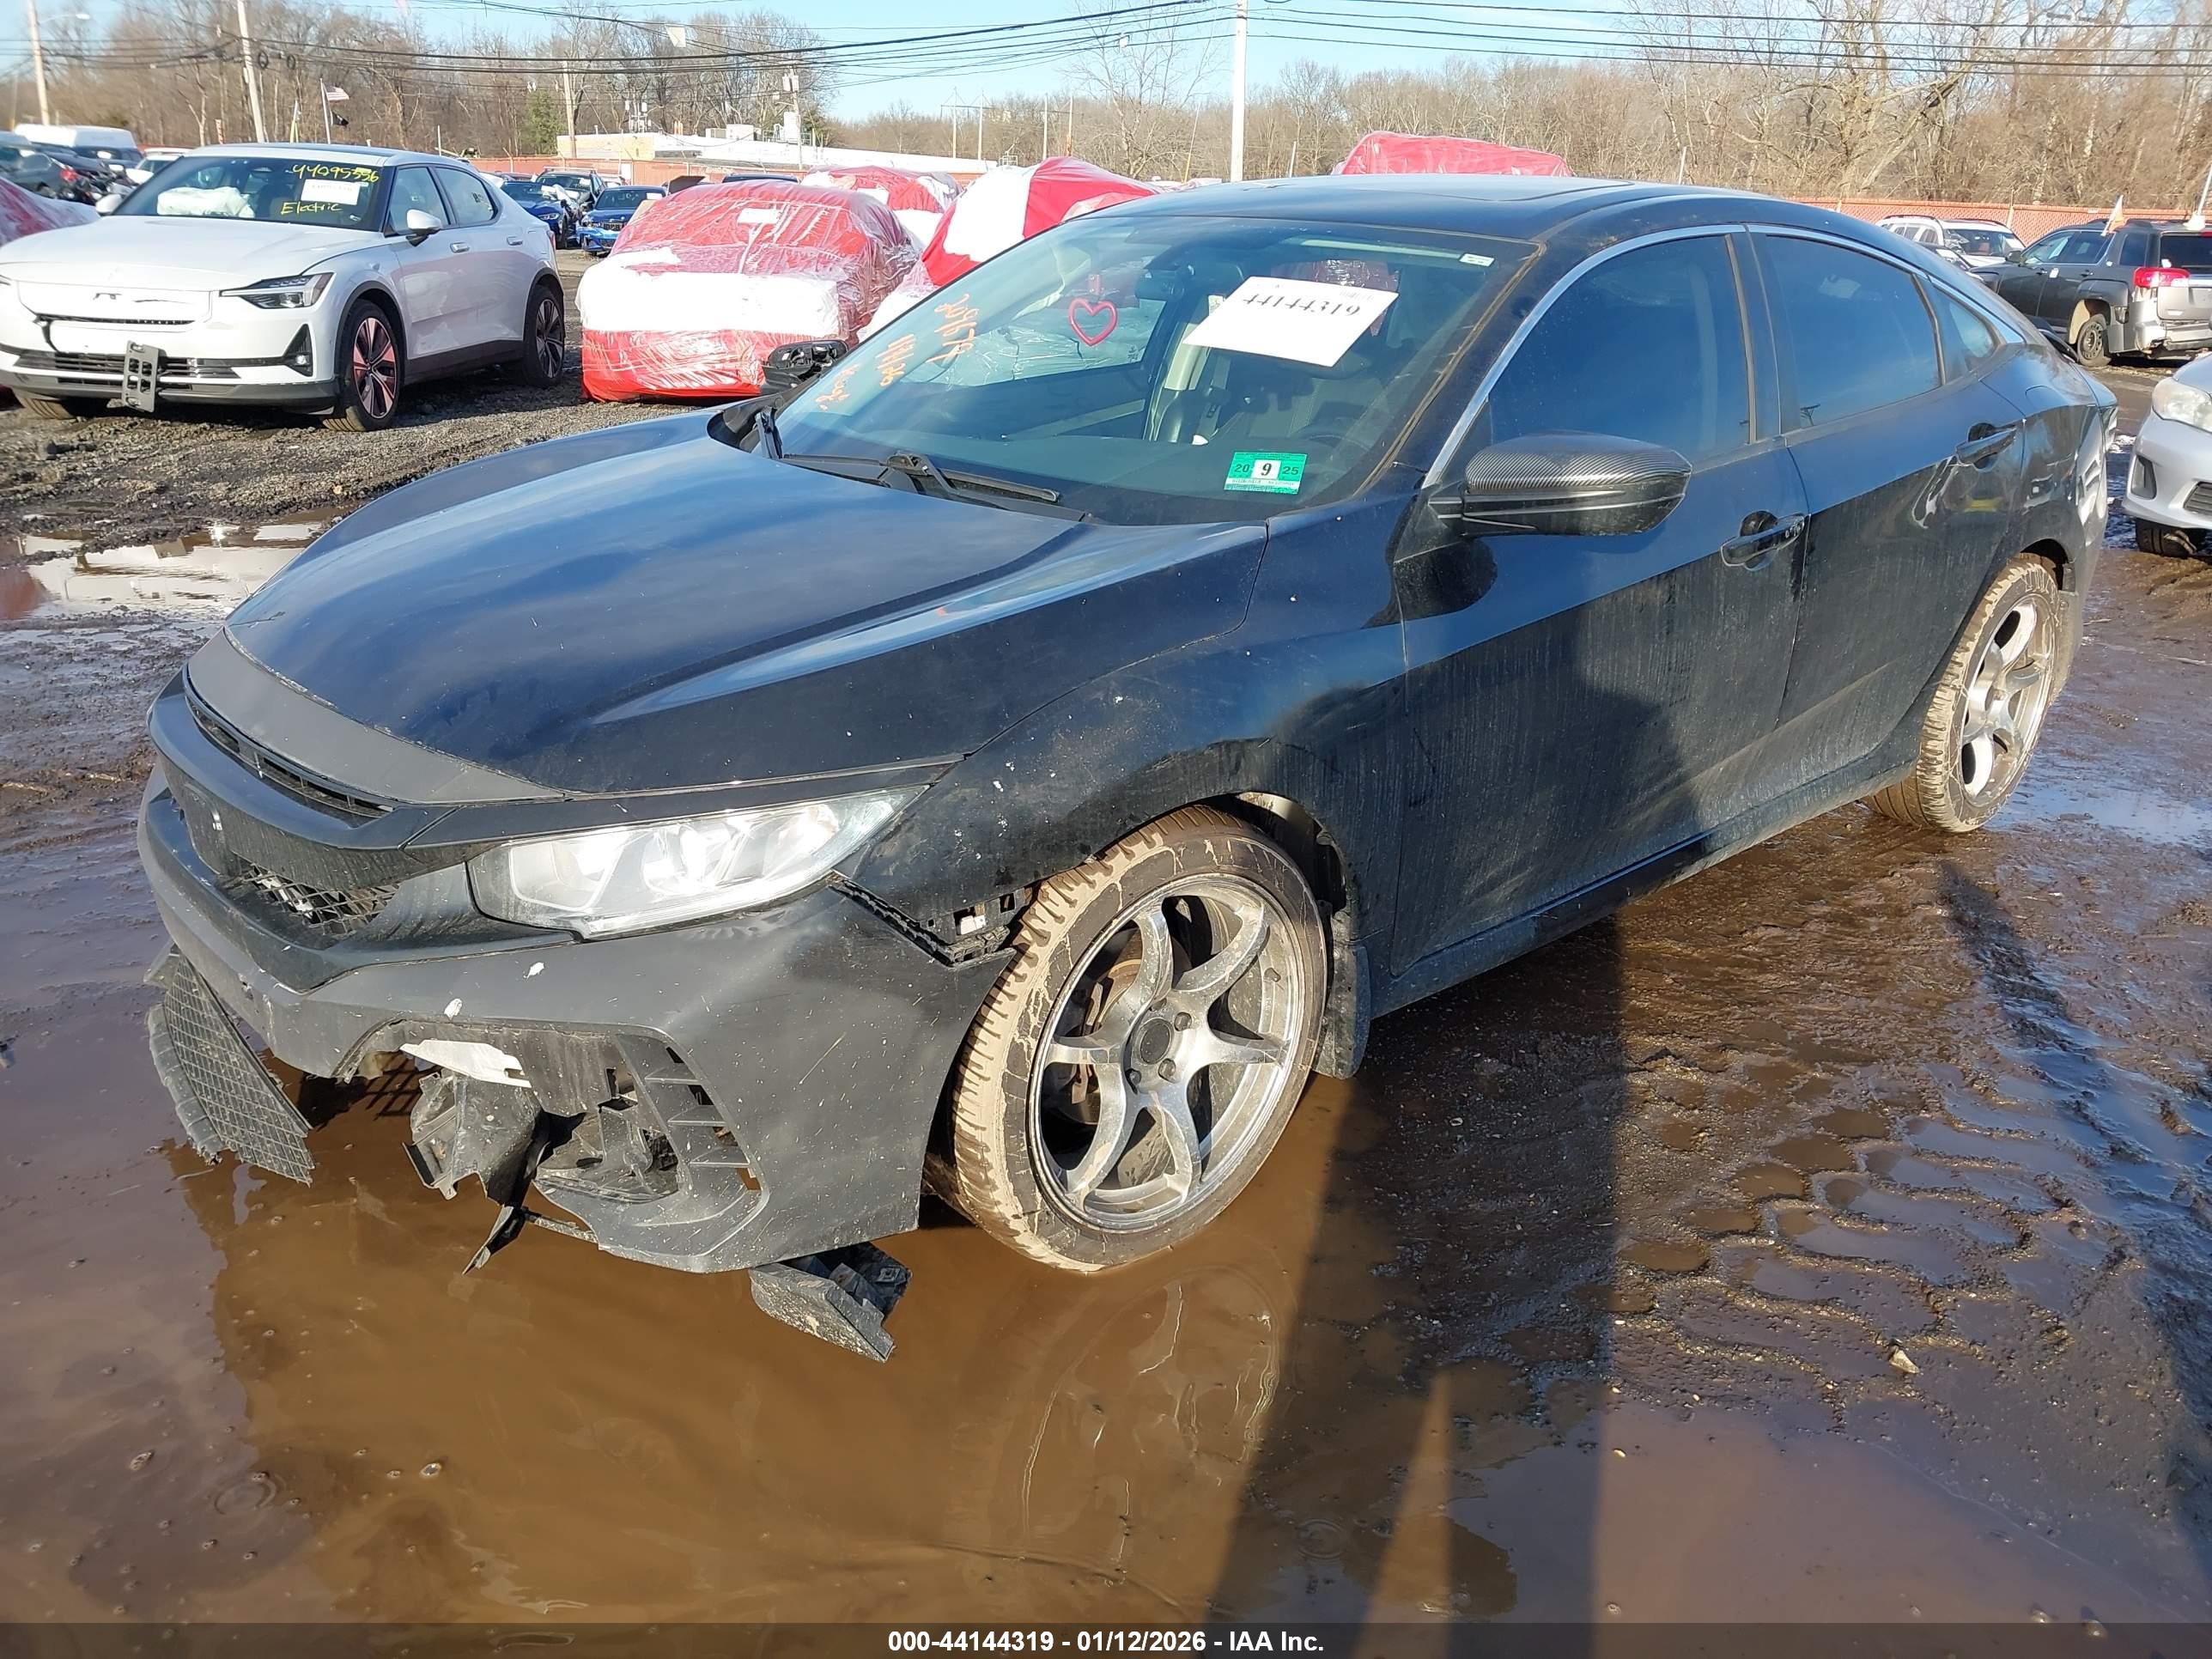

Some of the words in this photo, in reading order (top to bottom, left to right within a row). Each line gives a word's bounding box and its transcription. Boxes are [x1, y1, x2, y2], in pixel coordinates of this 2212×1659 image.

[281, 201, 342, 215] Electric
[1235, 464, 1249, 473] 20
[1261, 463, 1272, 476] 9
[1282, 465, 1298, 475] 25
